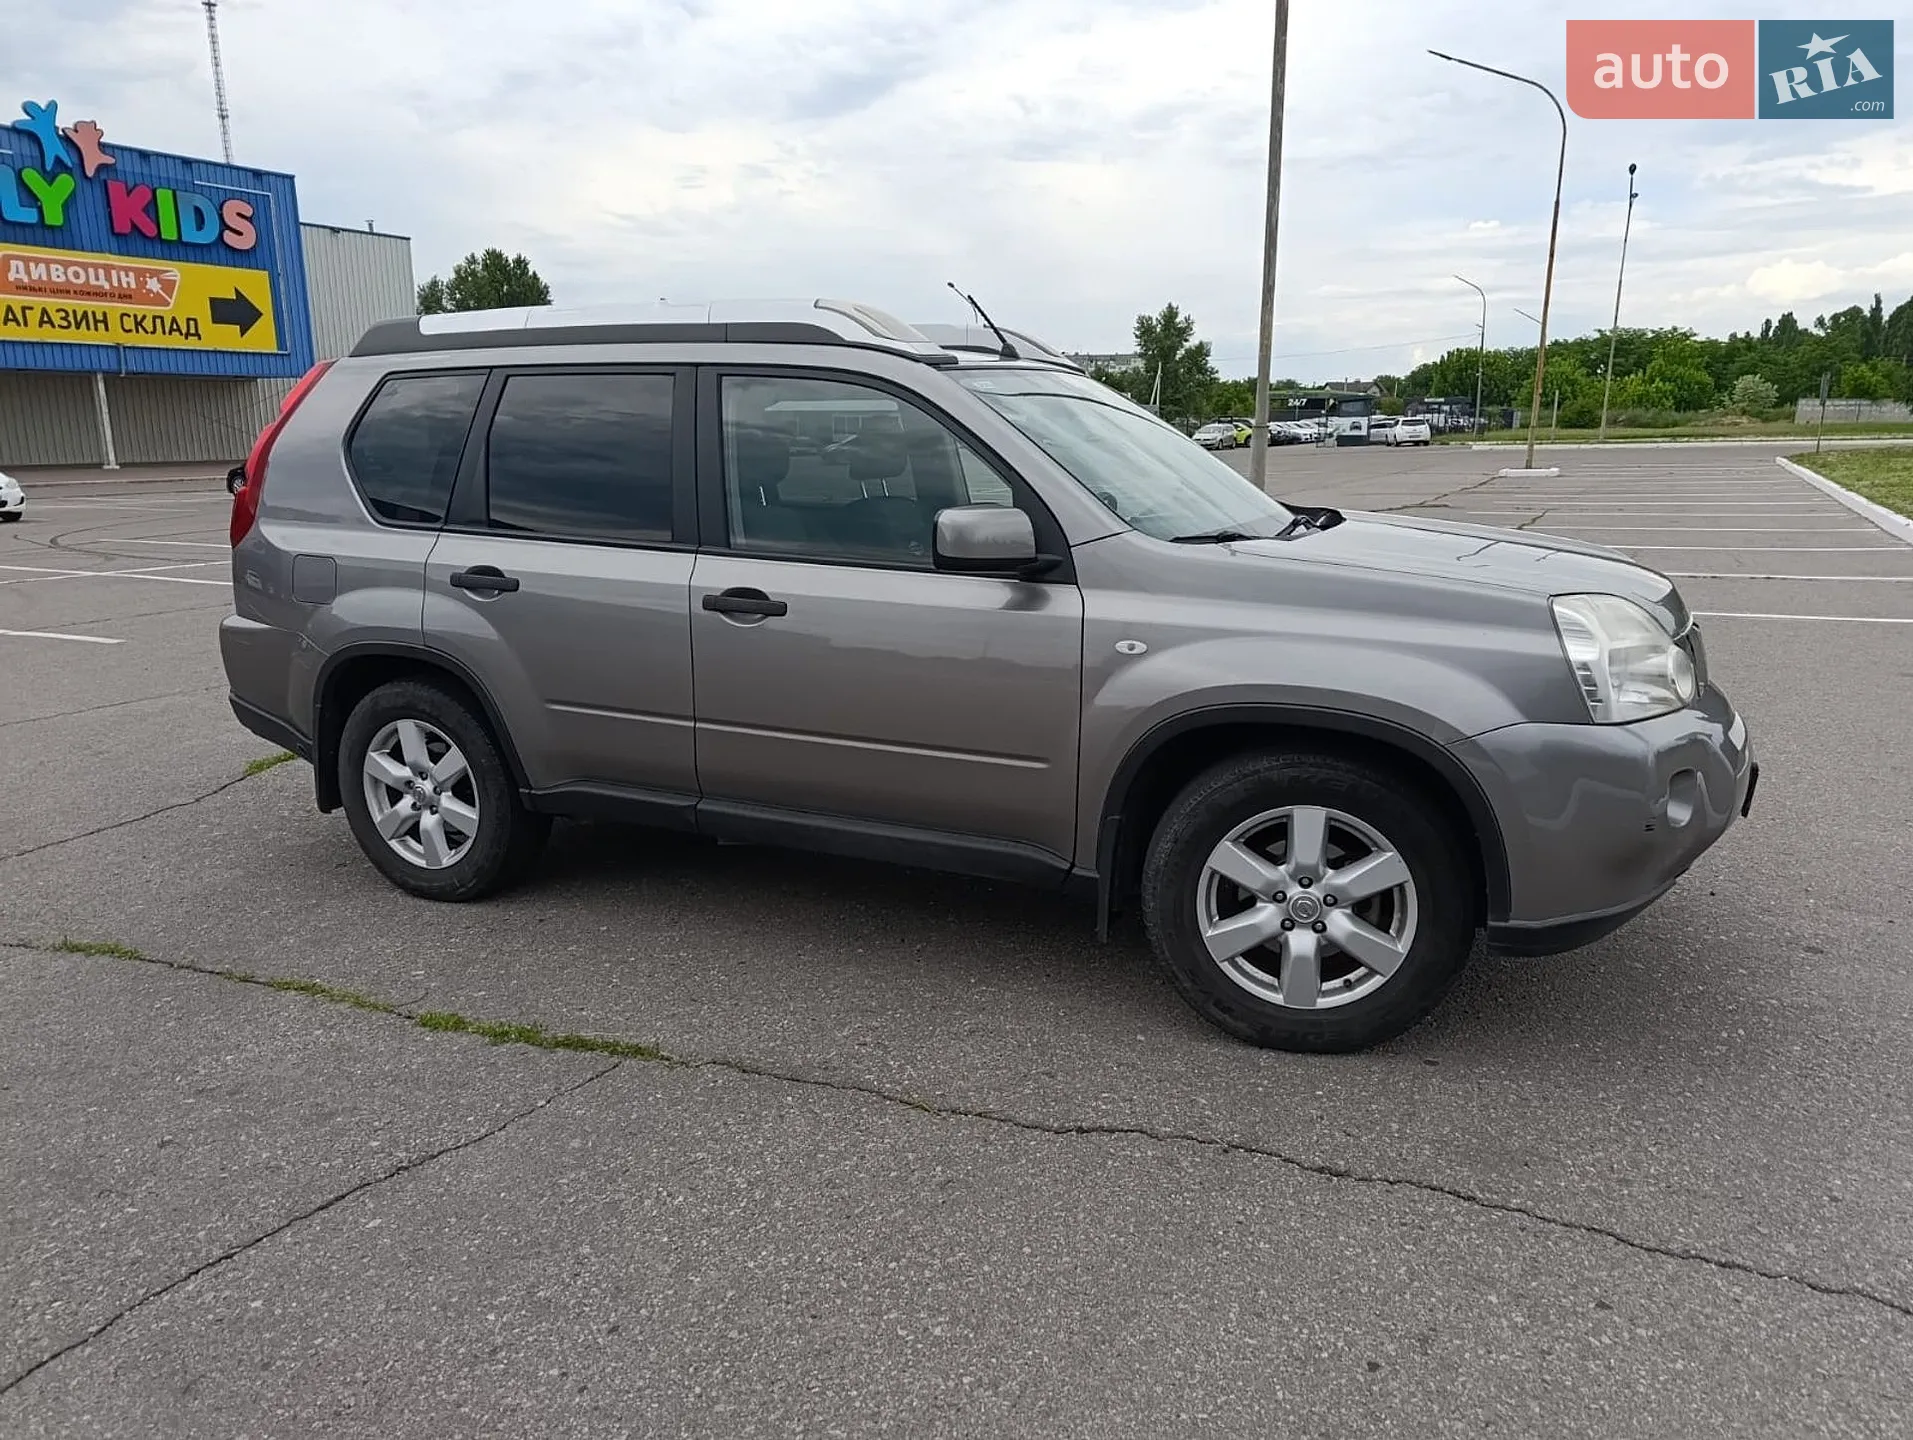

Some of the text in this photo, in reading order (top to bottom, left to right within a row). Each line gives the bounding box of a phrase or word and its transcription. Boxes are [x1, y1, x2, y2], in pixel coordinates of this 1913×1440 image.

[0, 164, 257, 250] LY KIDS
[8, 259, 137, 290] ДИВОЦІН
[3, 304, 202, 340] АГАЗИН СКЛАД
